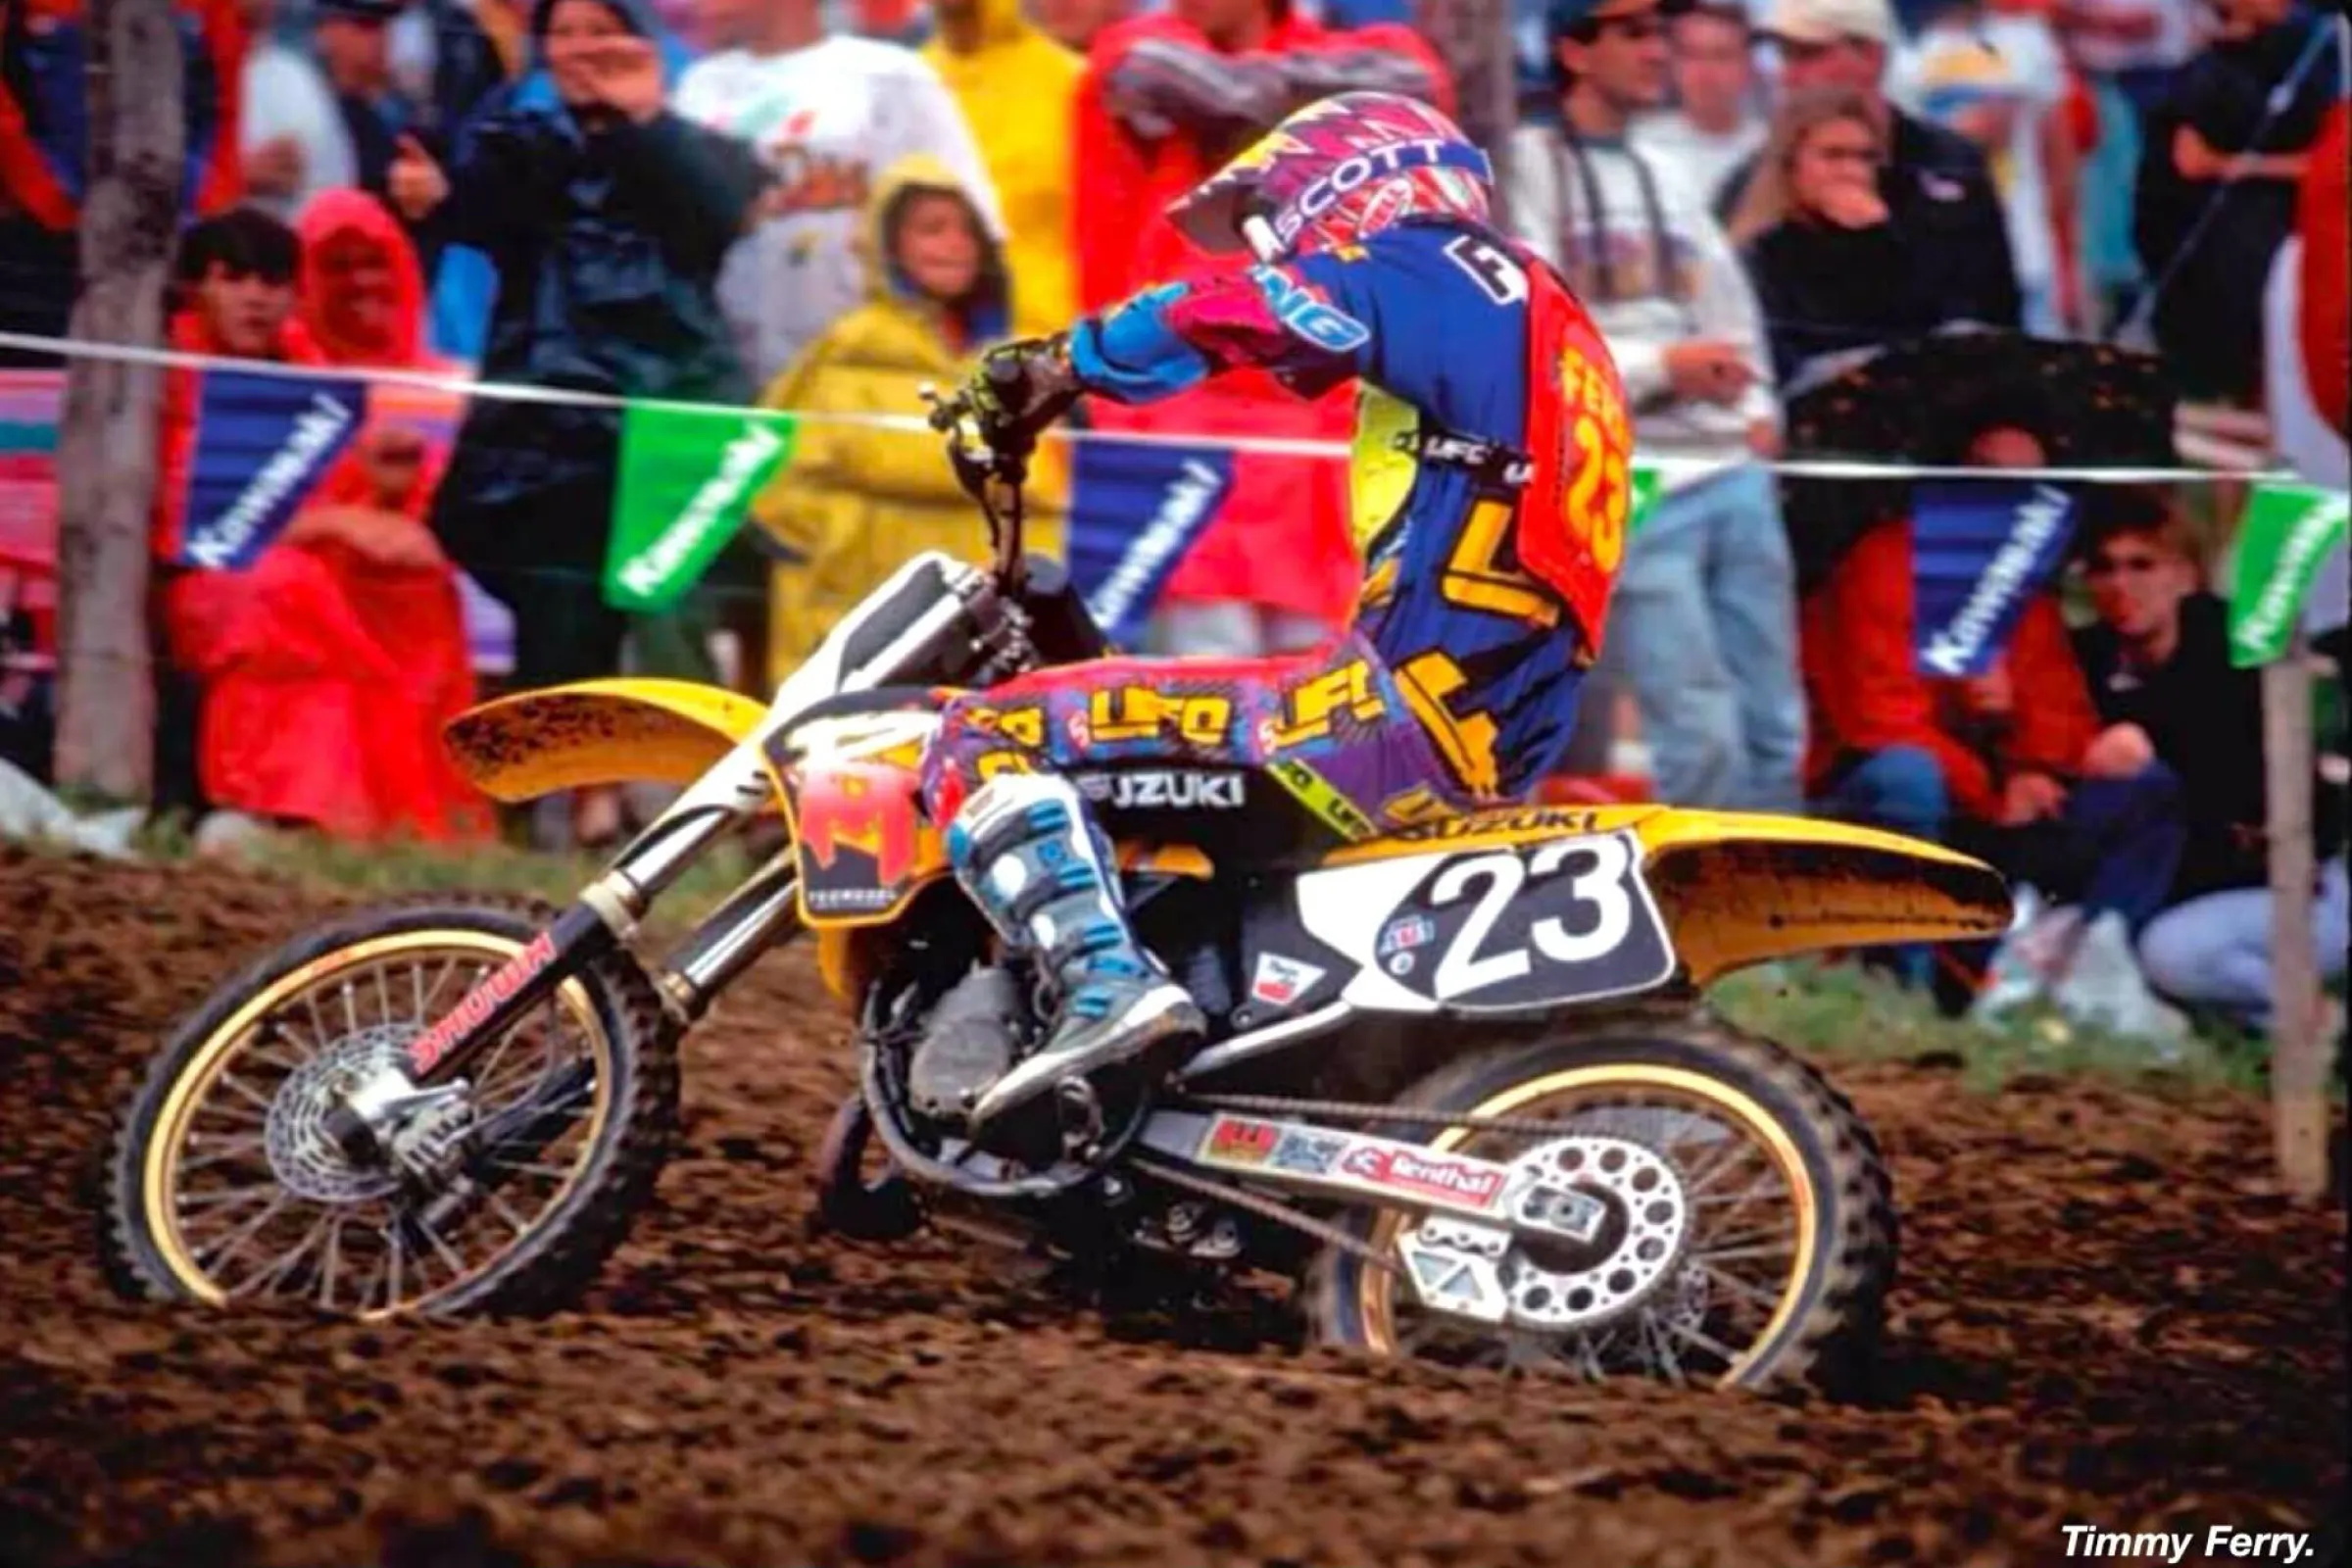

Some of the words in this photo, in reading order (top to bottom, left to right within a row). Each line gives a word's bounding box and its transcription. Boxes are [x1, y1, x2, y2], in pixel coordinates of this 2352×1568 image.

[1275, 138, 1446, 245] SCOTT
[186, 391, 351, 568] Kawasaki
[616, 423, 782, 597] Kawasaki
[1568, 413, 1627, 573] 23
[1922, 482, 2073, 673] Kawasaki
[1429, 835, 1633, 1003] 23
[1390, 1155, 1496, 1195] Renthal
